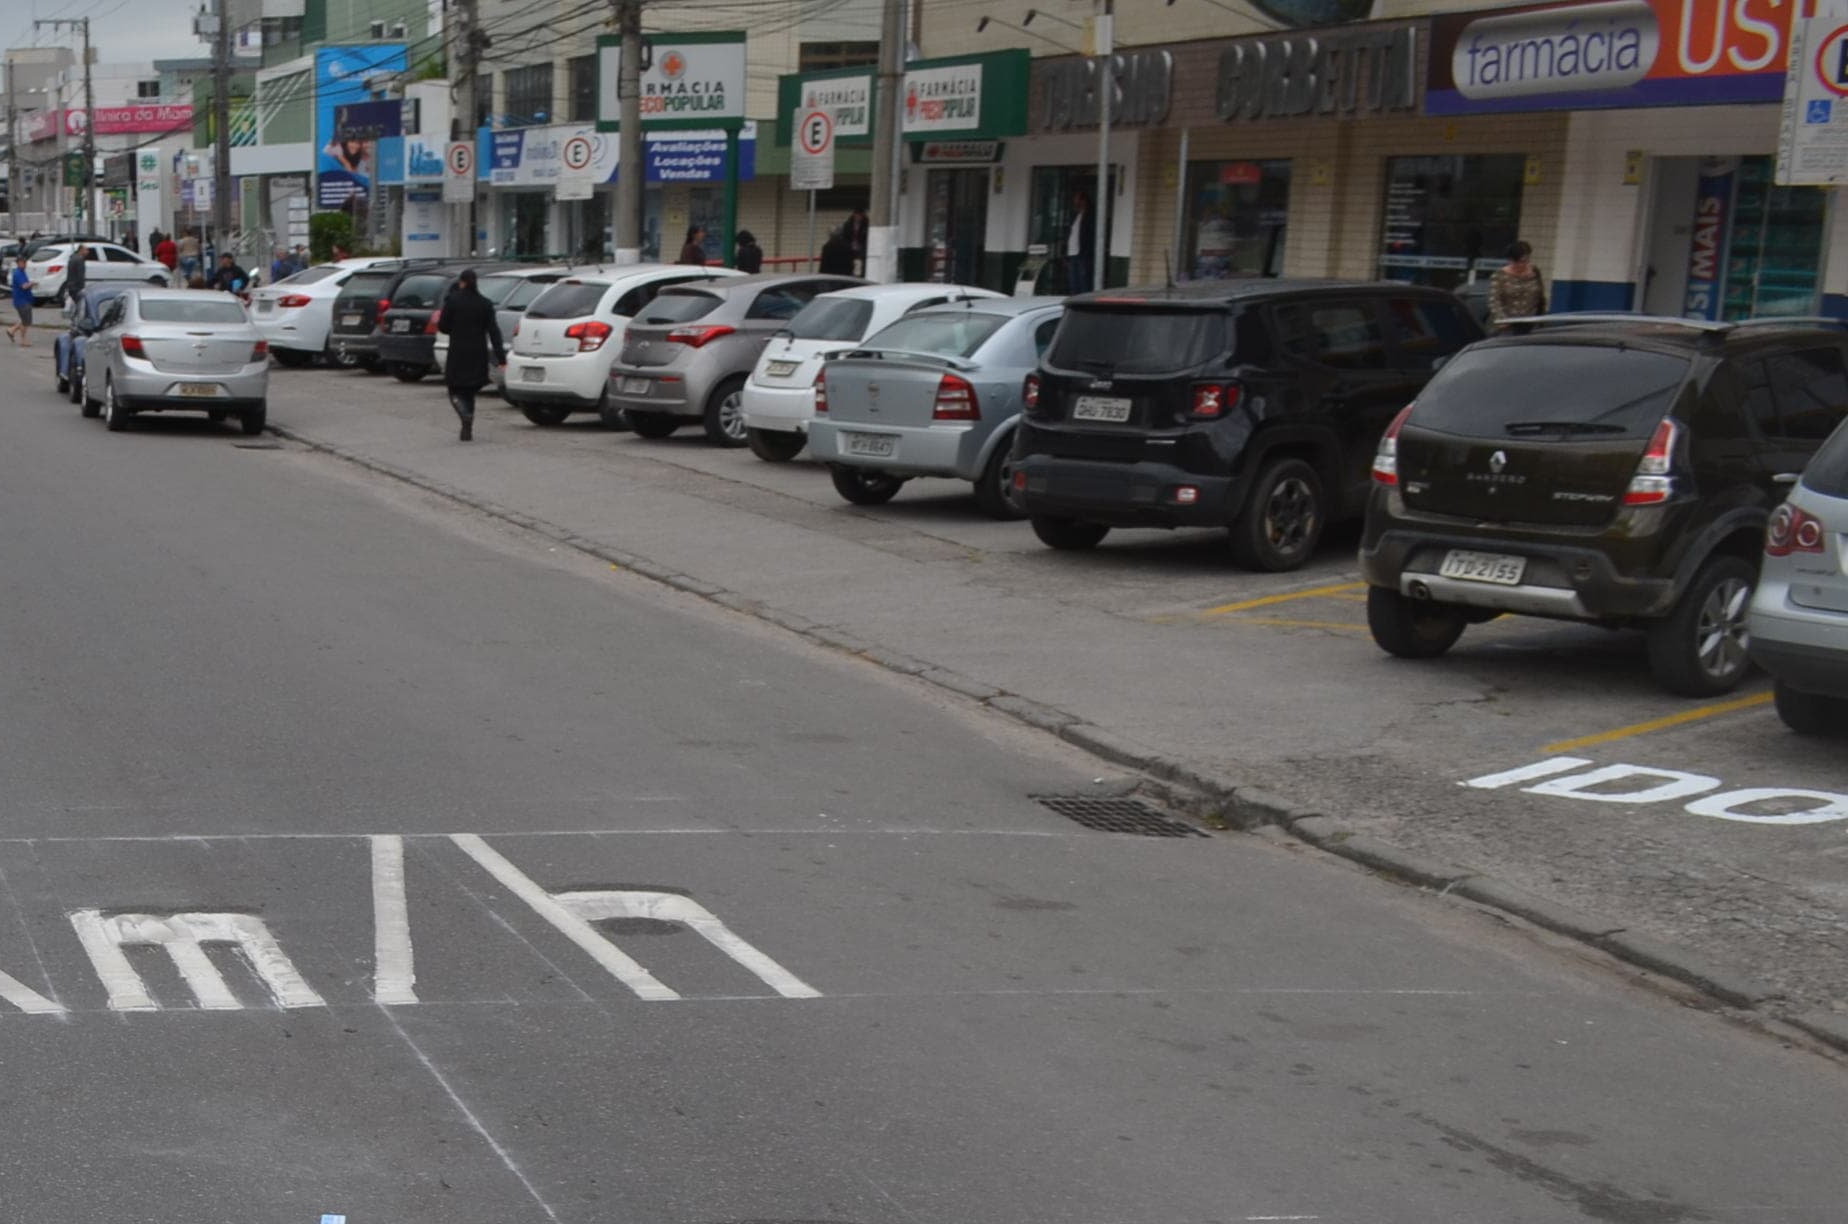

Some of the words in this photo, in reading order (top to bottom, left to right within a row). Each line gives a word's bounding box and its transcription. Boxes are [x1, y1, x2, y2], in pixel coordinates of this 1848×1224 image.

[1467, 20, 1641, 86] farmácia
[645, 80, 724, 94] RMÁCIA
[811, 121, 821, 145] E
